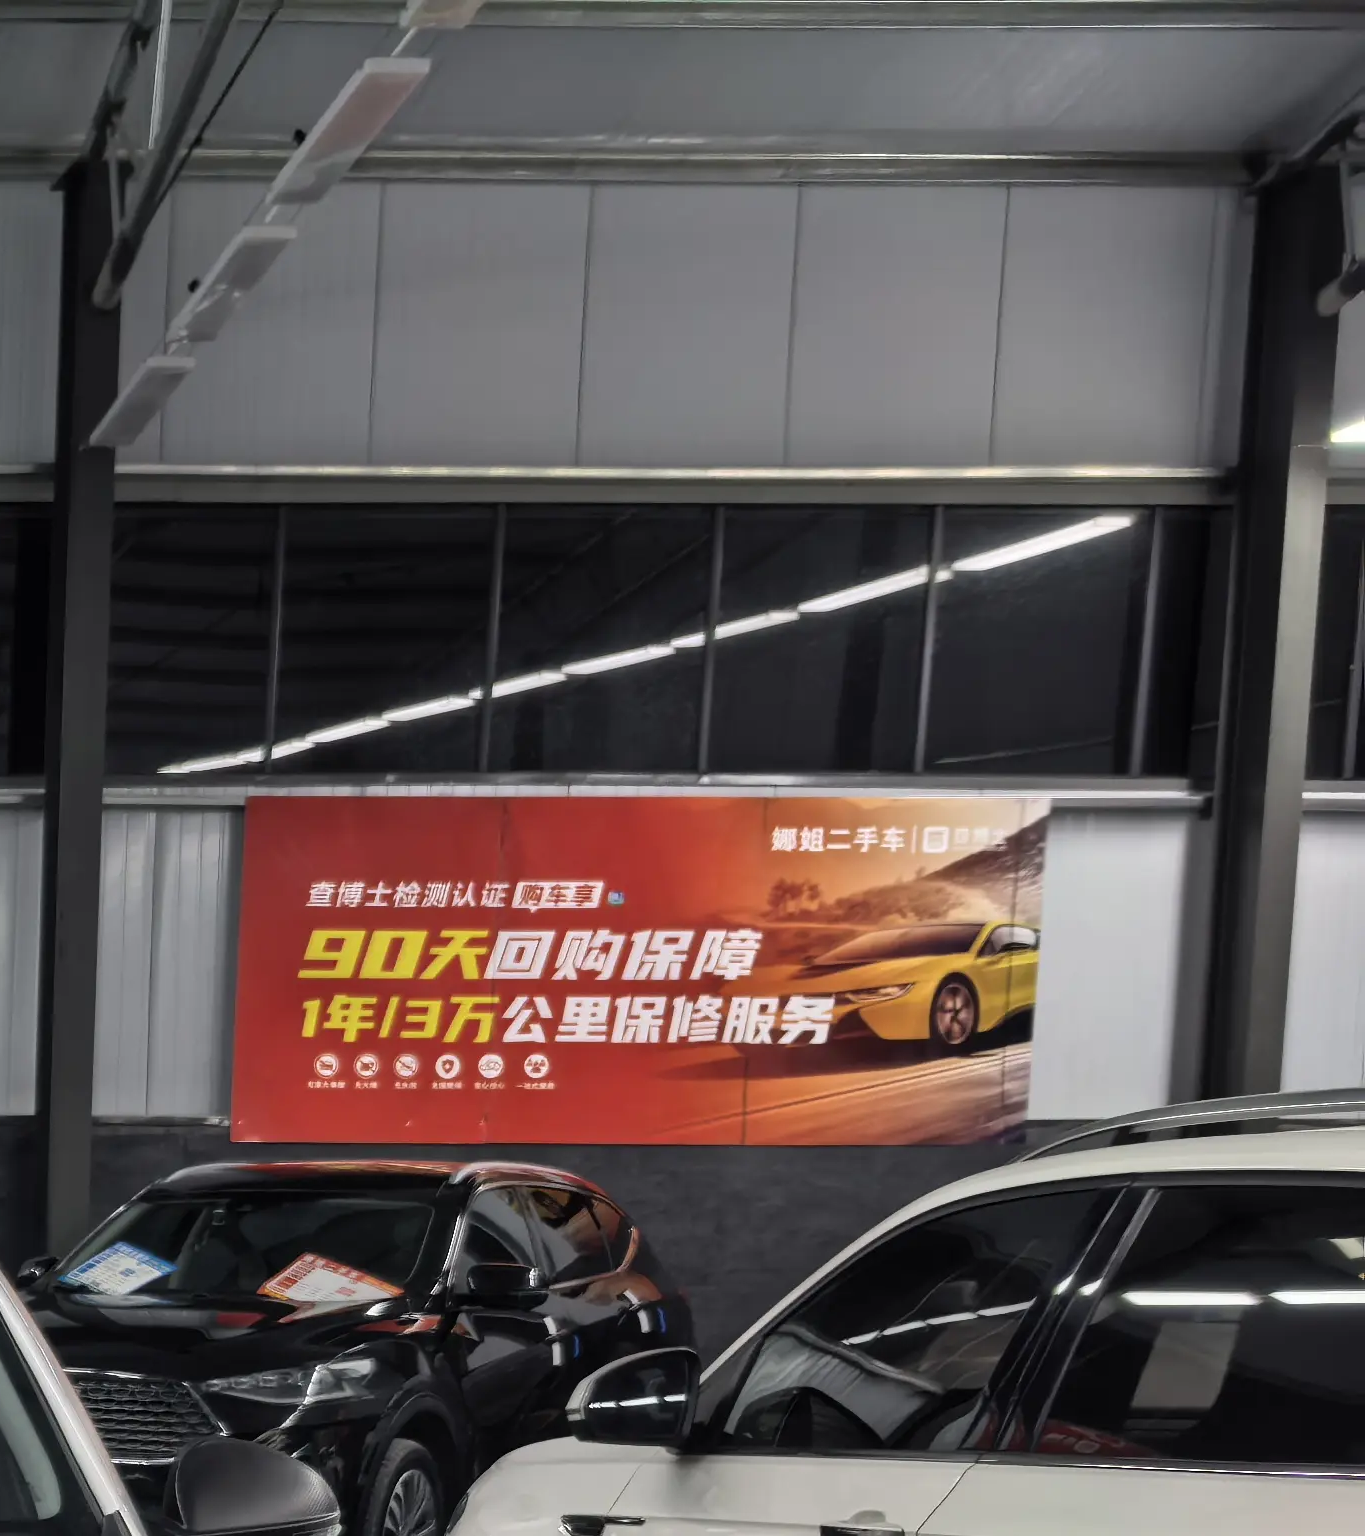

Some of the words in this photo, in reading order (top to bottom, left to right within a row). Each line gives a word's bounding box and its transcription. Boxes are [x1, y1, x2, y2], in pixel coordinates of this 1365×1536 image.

[771, 826, 906, 852] 娜姐二手车
[305, 880, 509, 908] 查博士检测认证
[519, 883, 598, 907] 购车享
[297, 929, 762, 981] 90天回购保障
[301, 993, 836, 1045] 1年/3万公里保修服务
